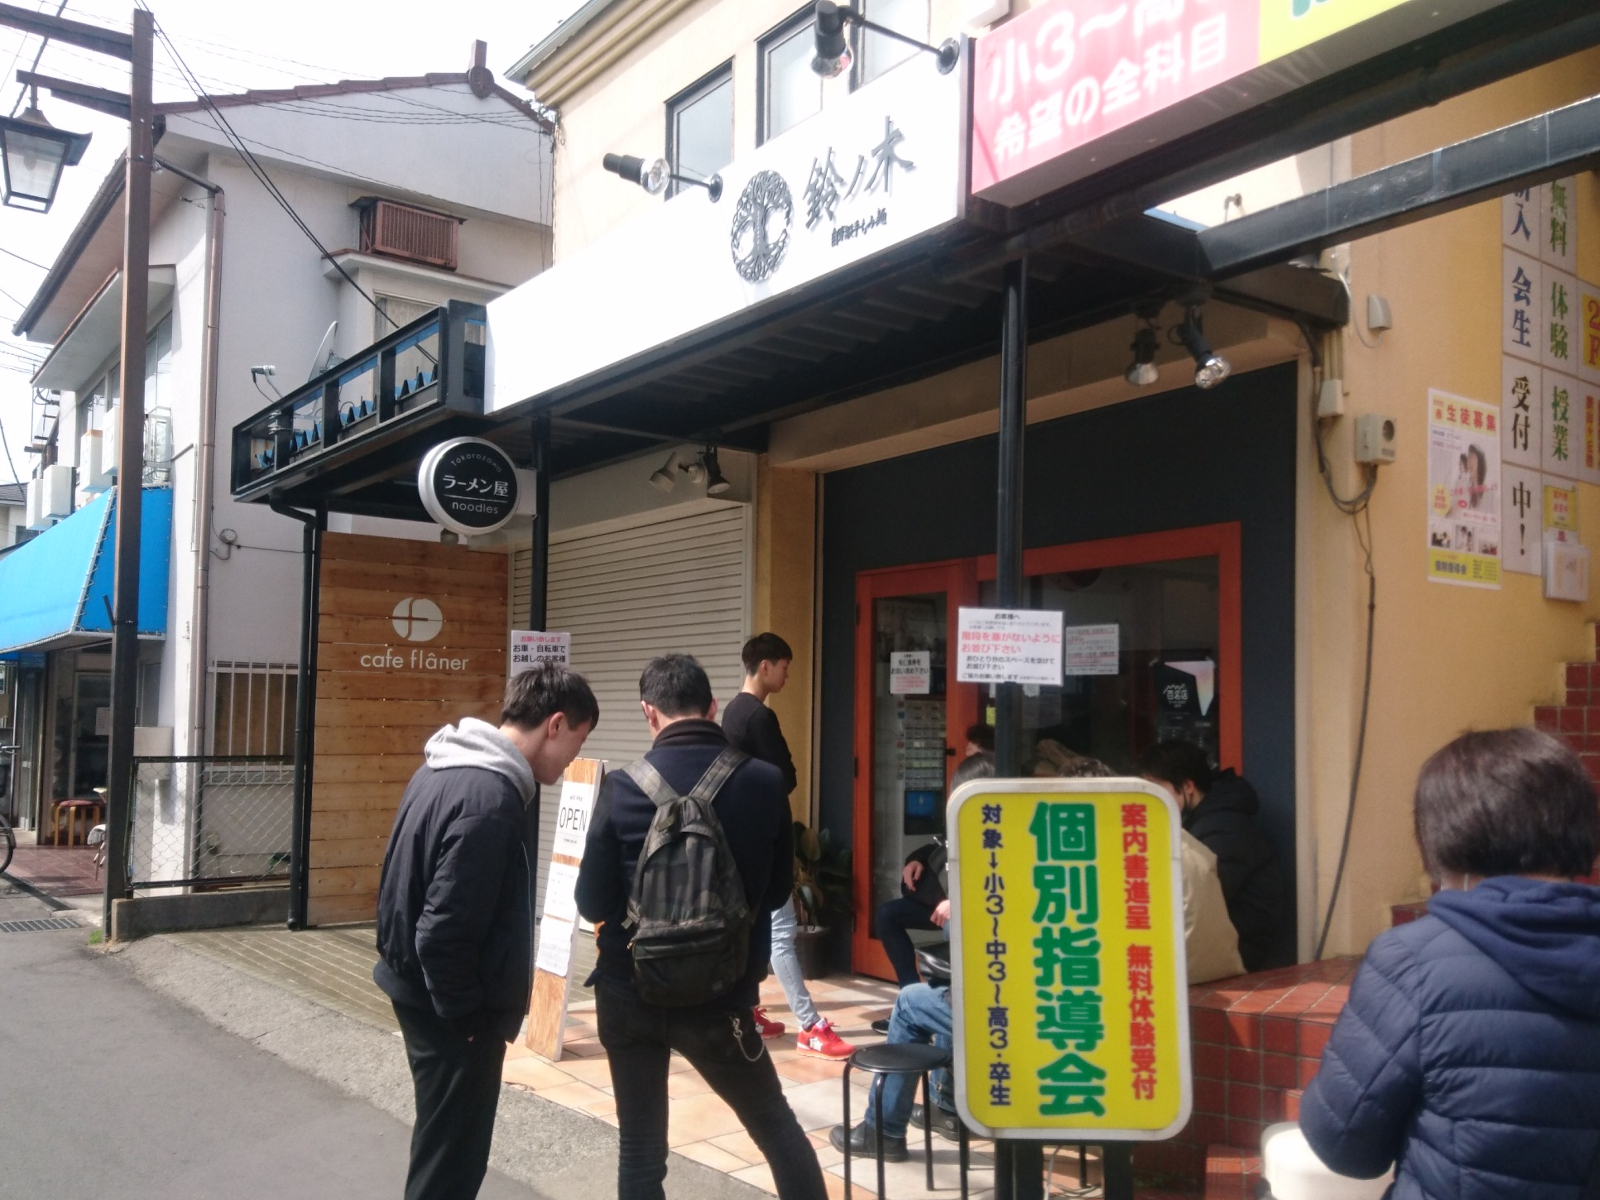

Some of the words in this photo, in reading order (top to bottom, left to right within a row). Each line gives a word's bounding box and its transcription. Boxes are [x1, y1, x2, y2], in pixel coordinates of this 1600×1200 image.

[993, 12, 1228, 163] 希望の全科目
[802, 115, 915, 230] 鈴ノ木
[442, 474, 509, 497] ラーメン屋
[452, 501, 499, 515] noodles
[360, 648, 404, 668] cafe
[410, 649, 469, 671] flâner
[961, 644, 1022, 653] お並び下さい
[559, 806, 588, 832] OPEN
[981, 803, 1004, 850] 対象
[1120, 803, 1152, 931] 案内書進呈
[1028, 801, 1107, 1118] 個別指導会
[1127, 944, 1158, 1101] 無料体験受付
